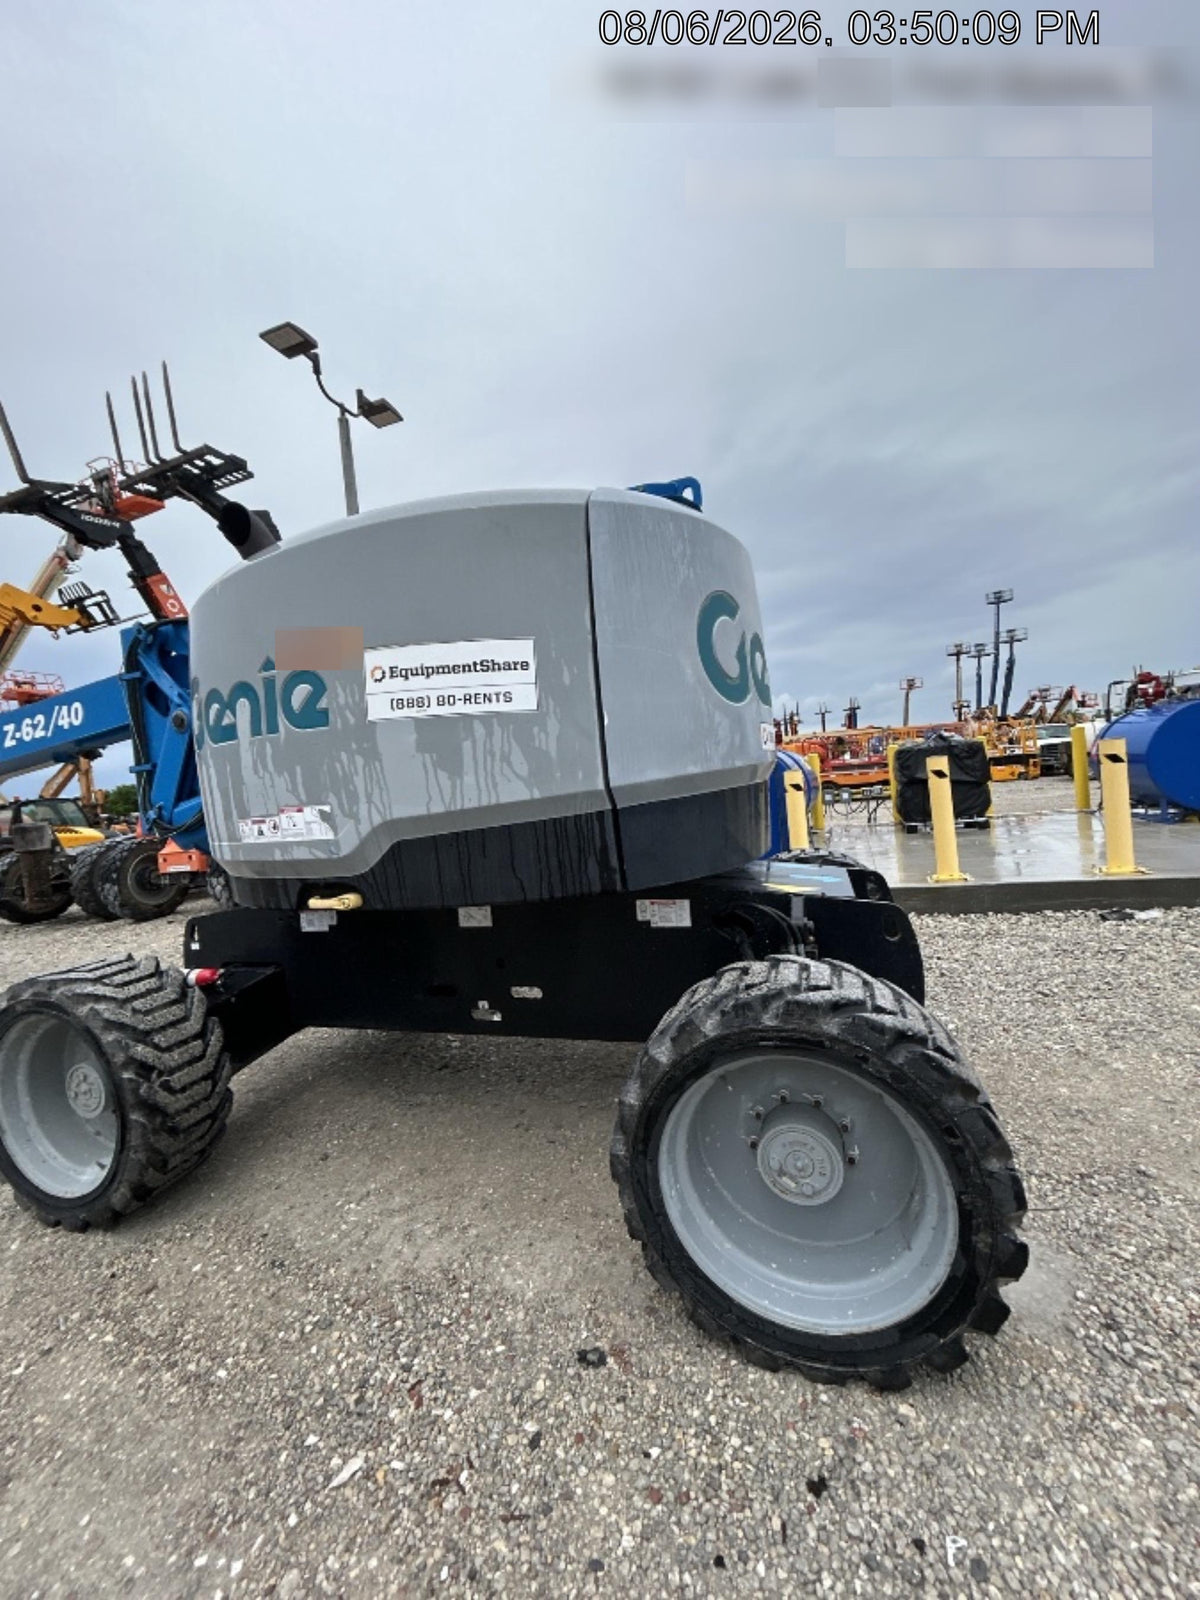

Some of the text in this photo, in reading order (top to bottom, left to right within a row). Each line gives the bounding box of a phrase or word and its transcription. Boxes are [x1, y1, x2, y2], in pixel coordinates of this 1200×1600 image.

[388, 658, 530, 682] EquipmentShare
[390, 694, 431, 712] (888)
[3, 701, 85, 748] Z-62/40
